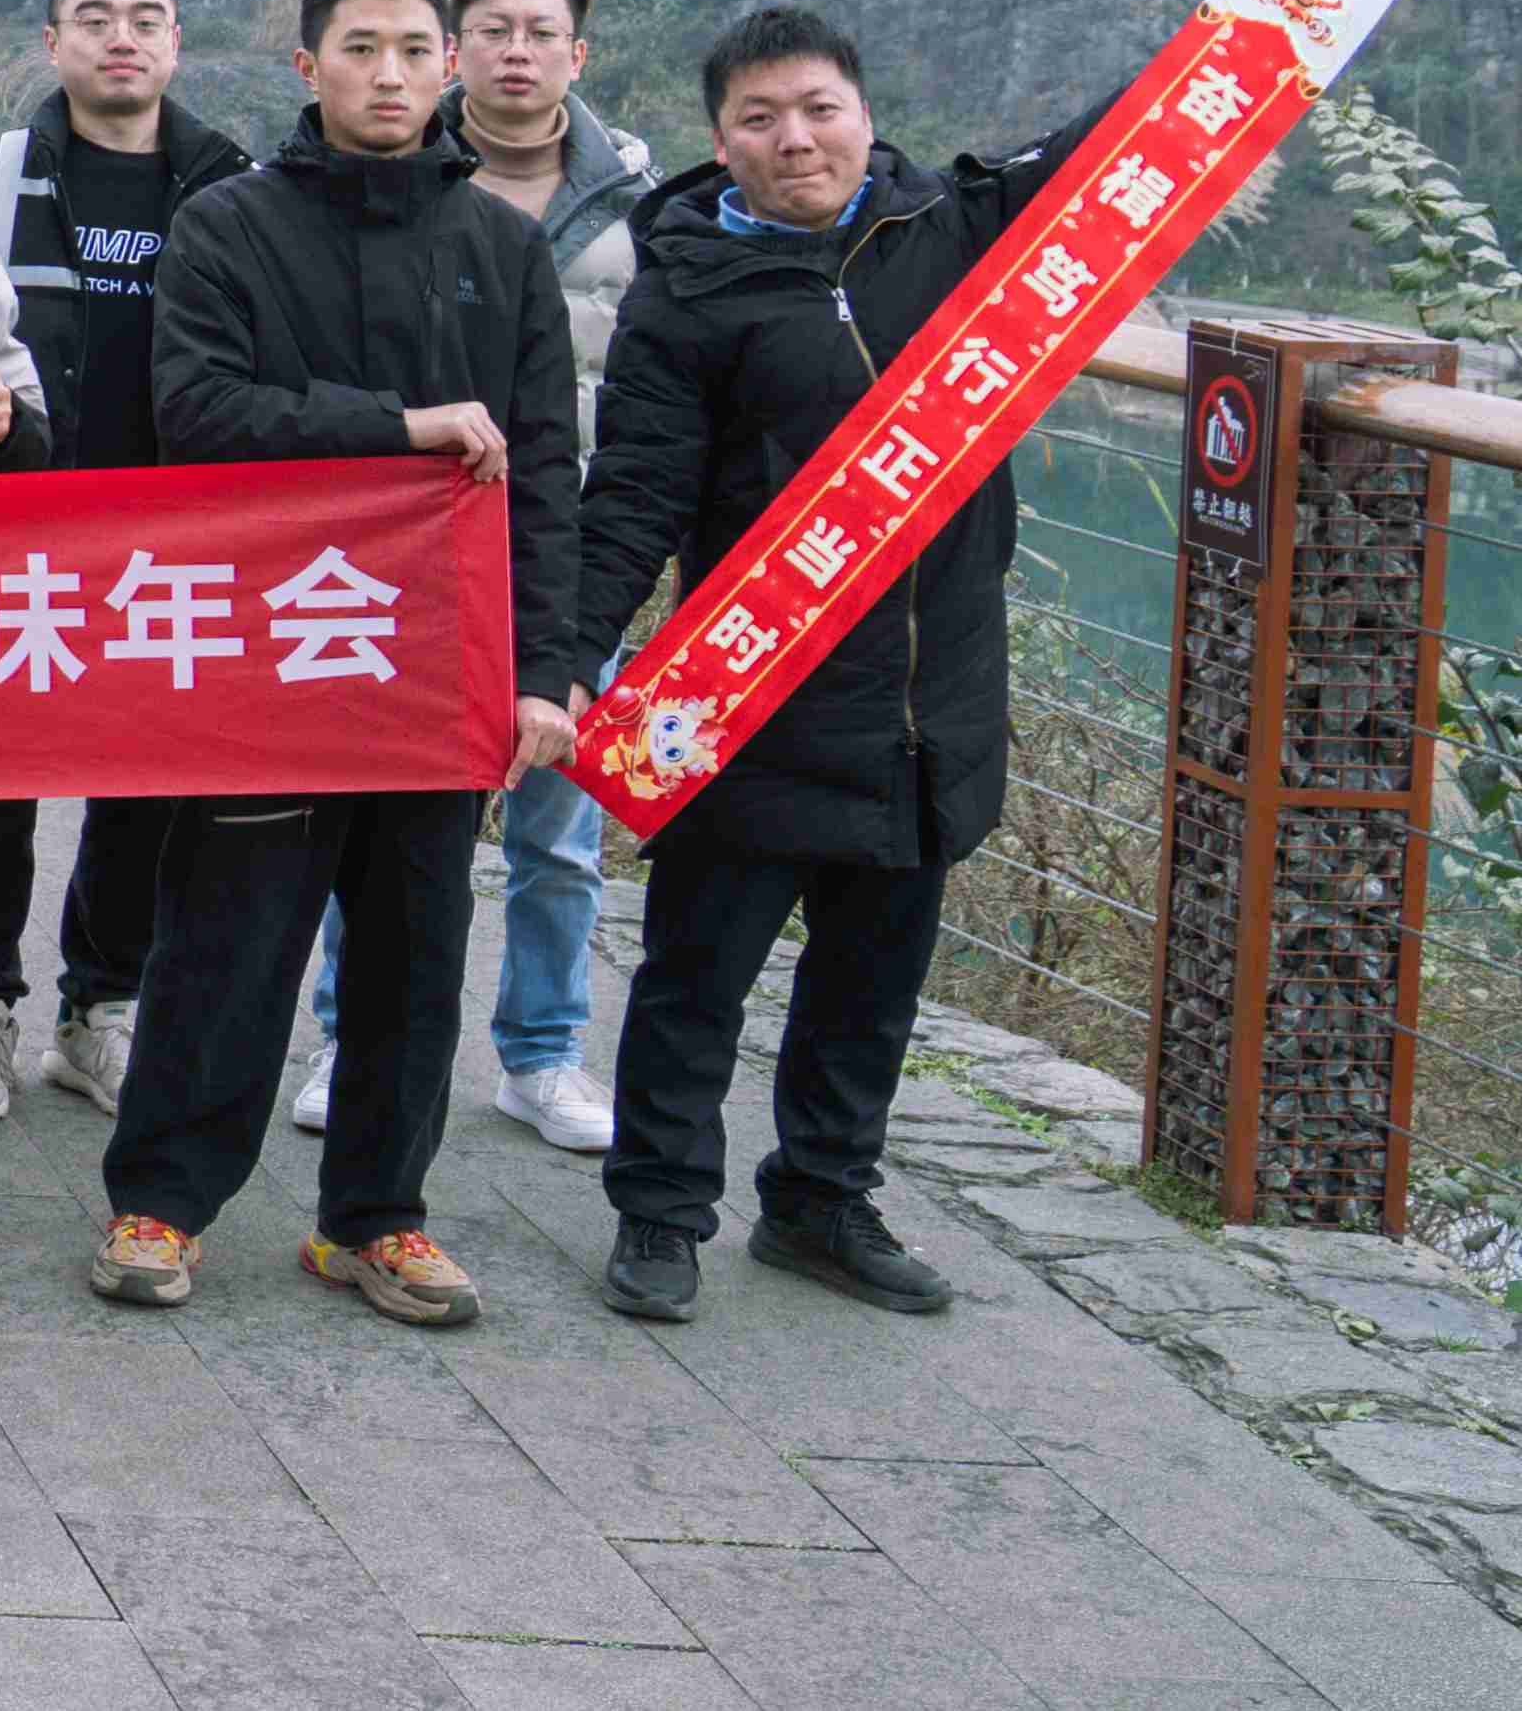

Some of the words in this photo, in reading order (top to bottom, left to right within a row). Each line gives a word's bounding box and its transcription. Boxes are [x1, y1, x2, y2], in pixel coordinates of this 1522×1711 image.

[84, 276, 122, 294] TCH
[705, 63, 1256, 675] 奋楫笃行正当时
